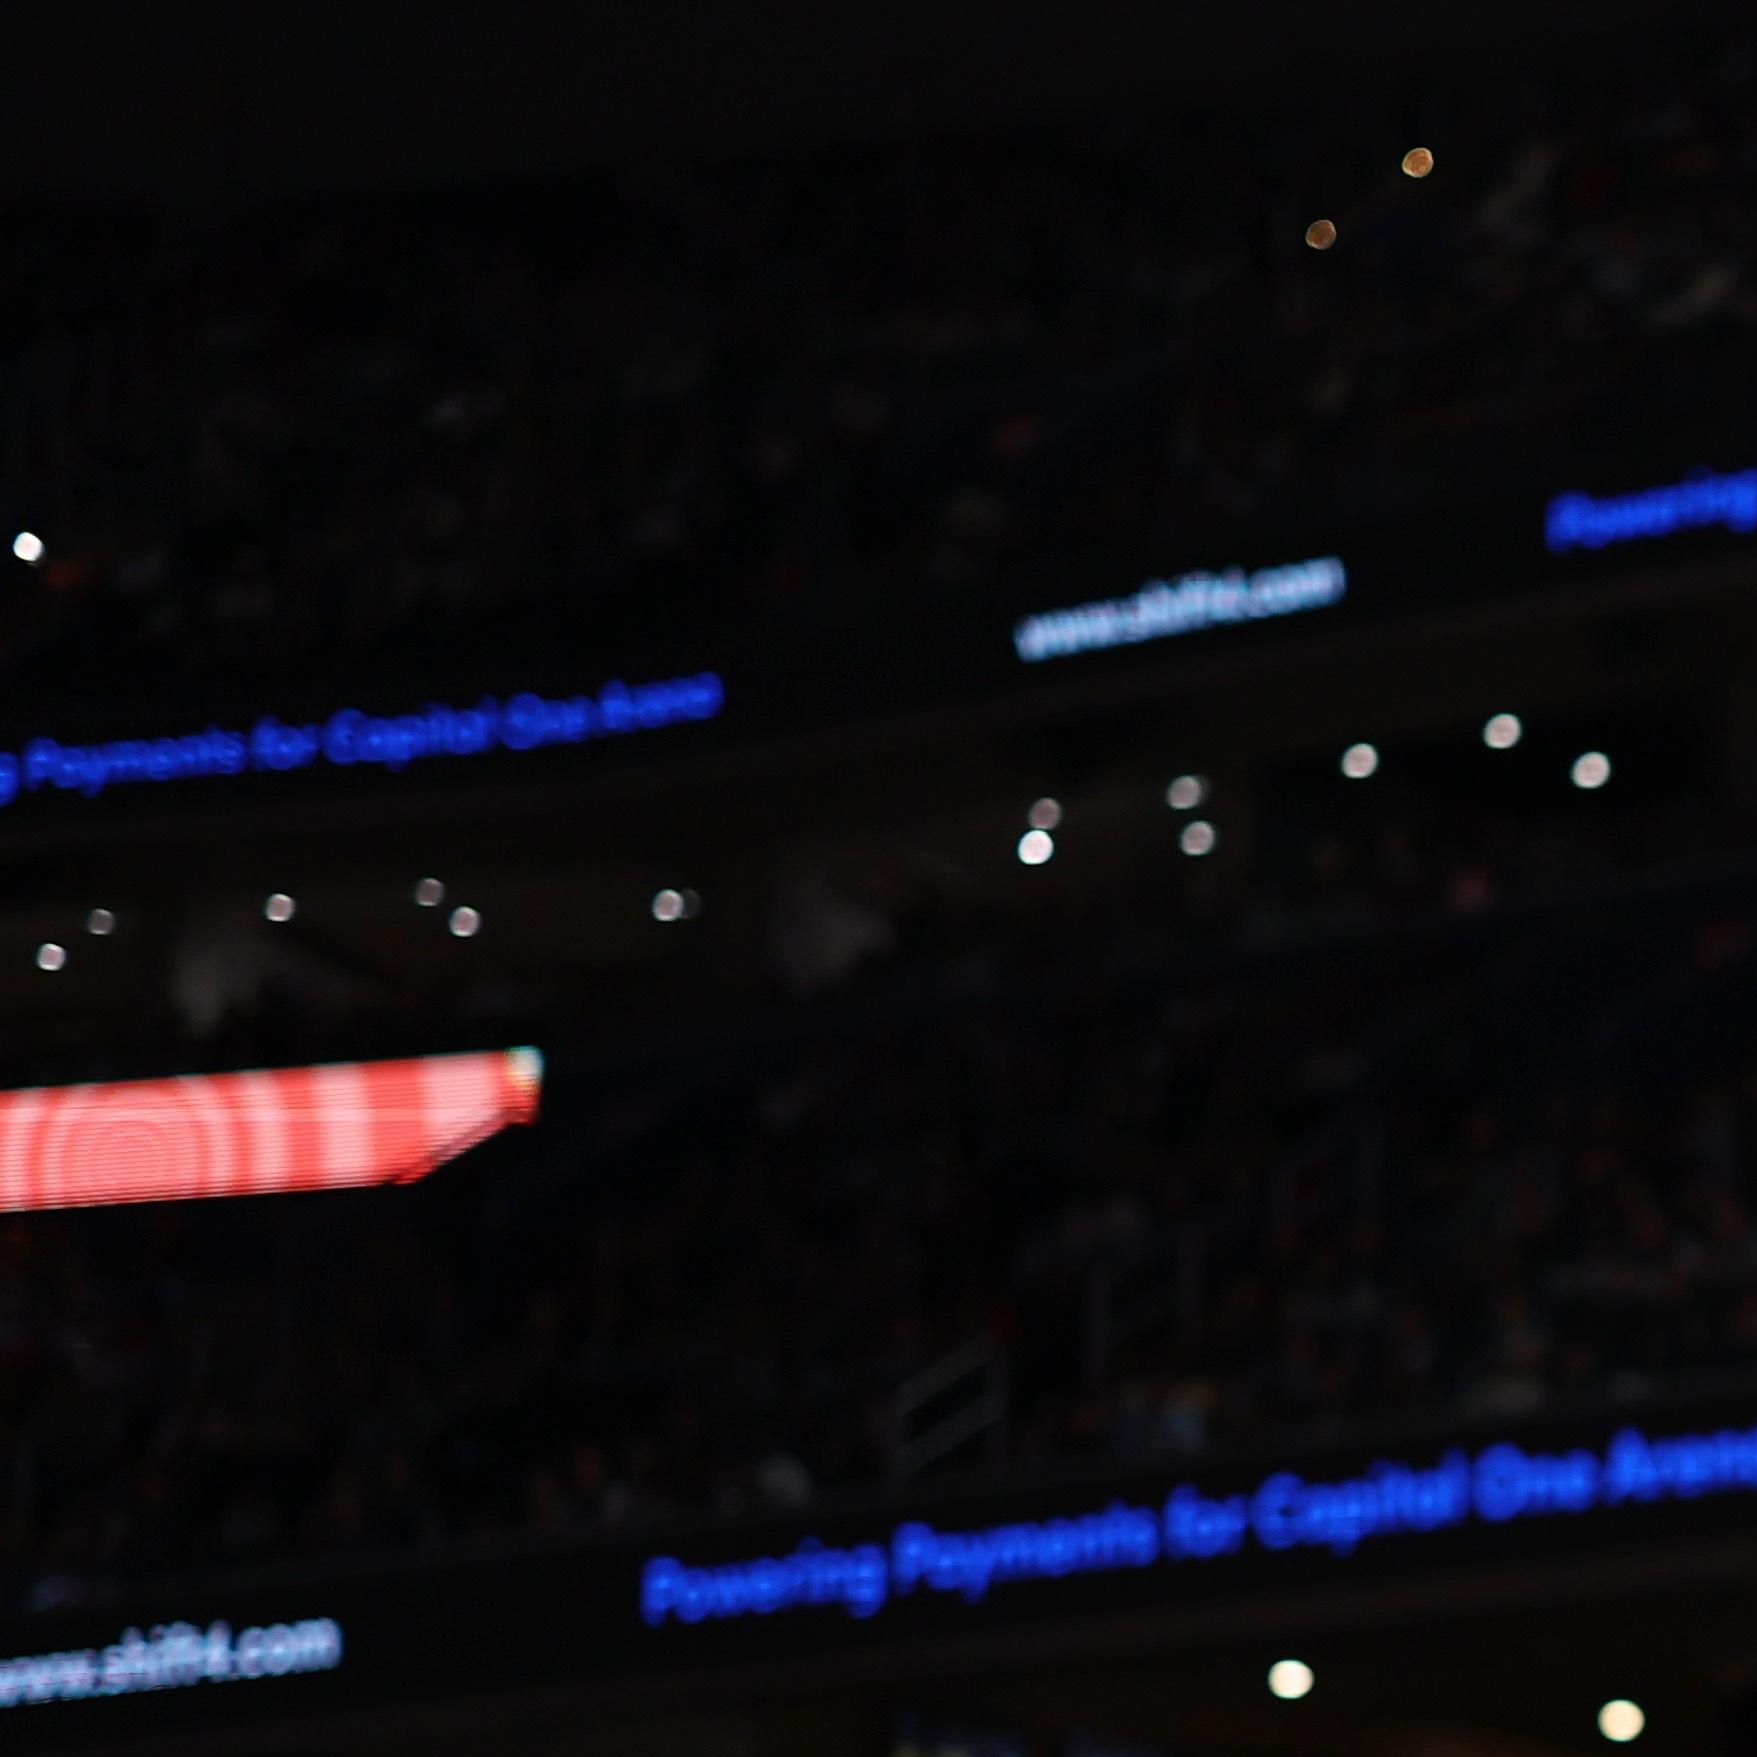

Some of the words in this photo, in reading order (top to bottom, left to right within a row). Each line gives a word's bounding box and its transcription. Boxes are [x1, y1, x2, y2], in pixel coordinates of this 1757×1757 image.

[641, 1536, 888, 1626] Powering
[891, 1500, 1158, 1603] Payments
[1162, 1483, 1250, 1560] for
[1253, 1445, 1469, 1558] Capital
[1472, 1442, 1600, 1523] One
